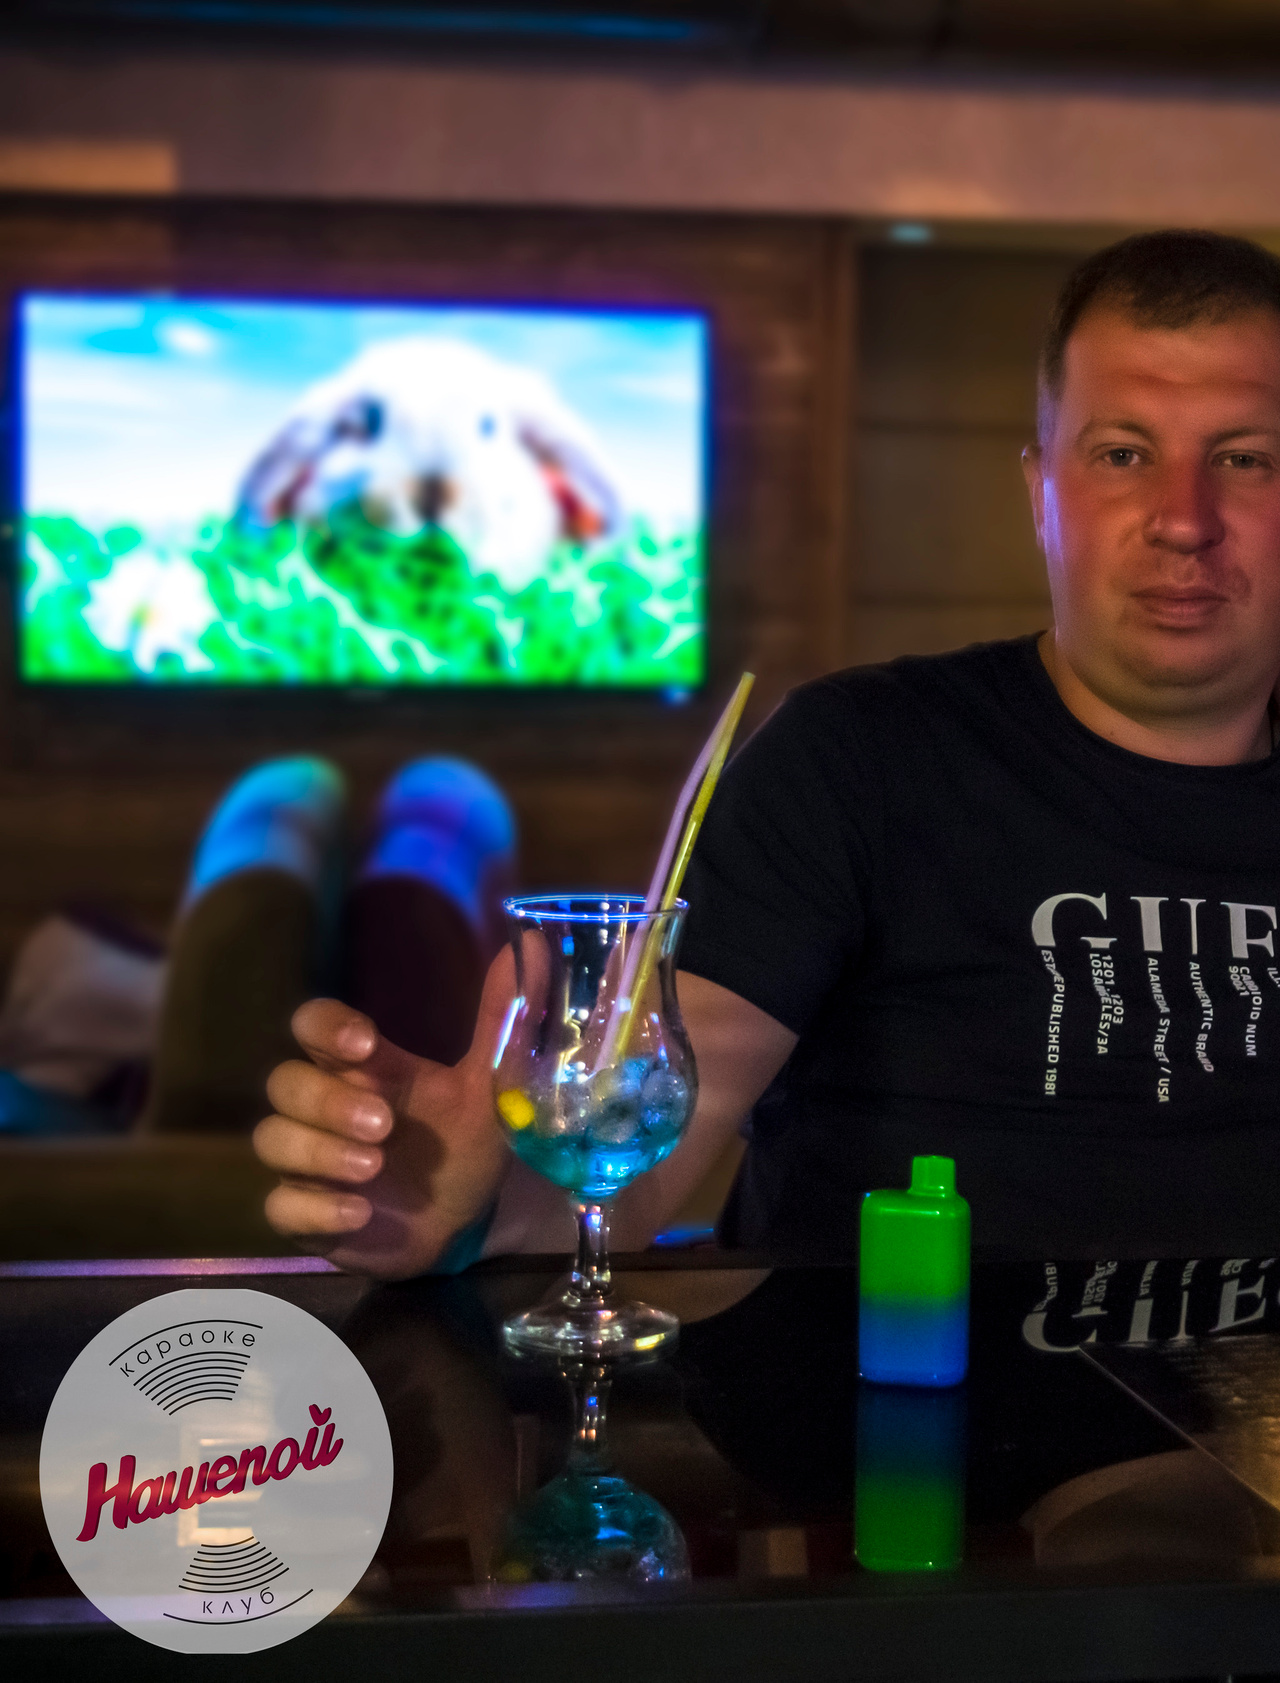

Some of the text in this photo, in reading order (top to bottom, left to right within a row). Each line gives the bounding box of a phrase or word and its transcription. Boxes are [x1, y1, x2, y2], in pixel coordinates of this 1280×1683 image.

[1147, 957, 1171, 1014] ALAMEDA
[1189, 961, 1215, 1073] AUTHENTIC BRAND
[1239, 966, 1263, 1057] CARDIOID NUM
[1153, 1018, 1171, 1063] STREET
[1044, 1067, 1058, 1096] 1981
[1157, 1078, 1170, 1103] USA
